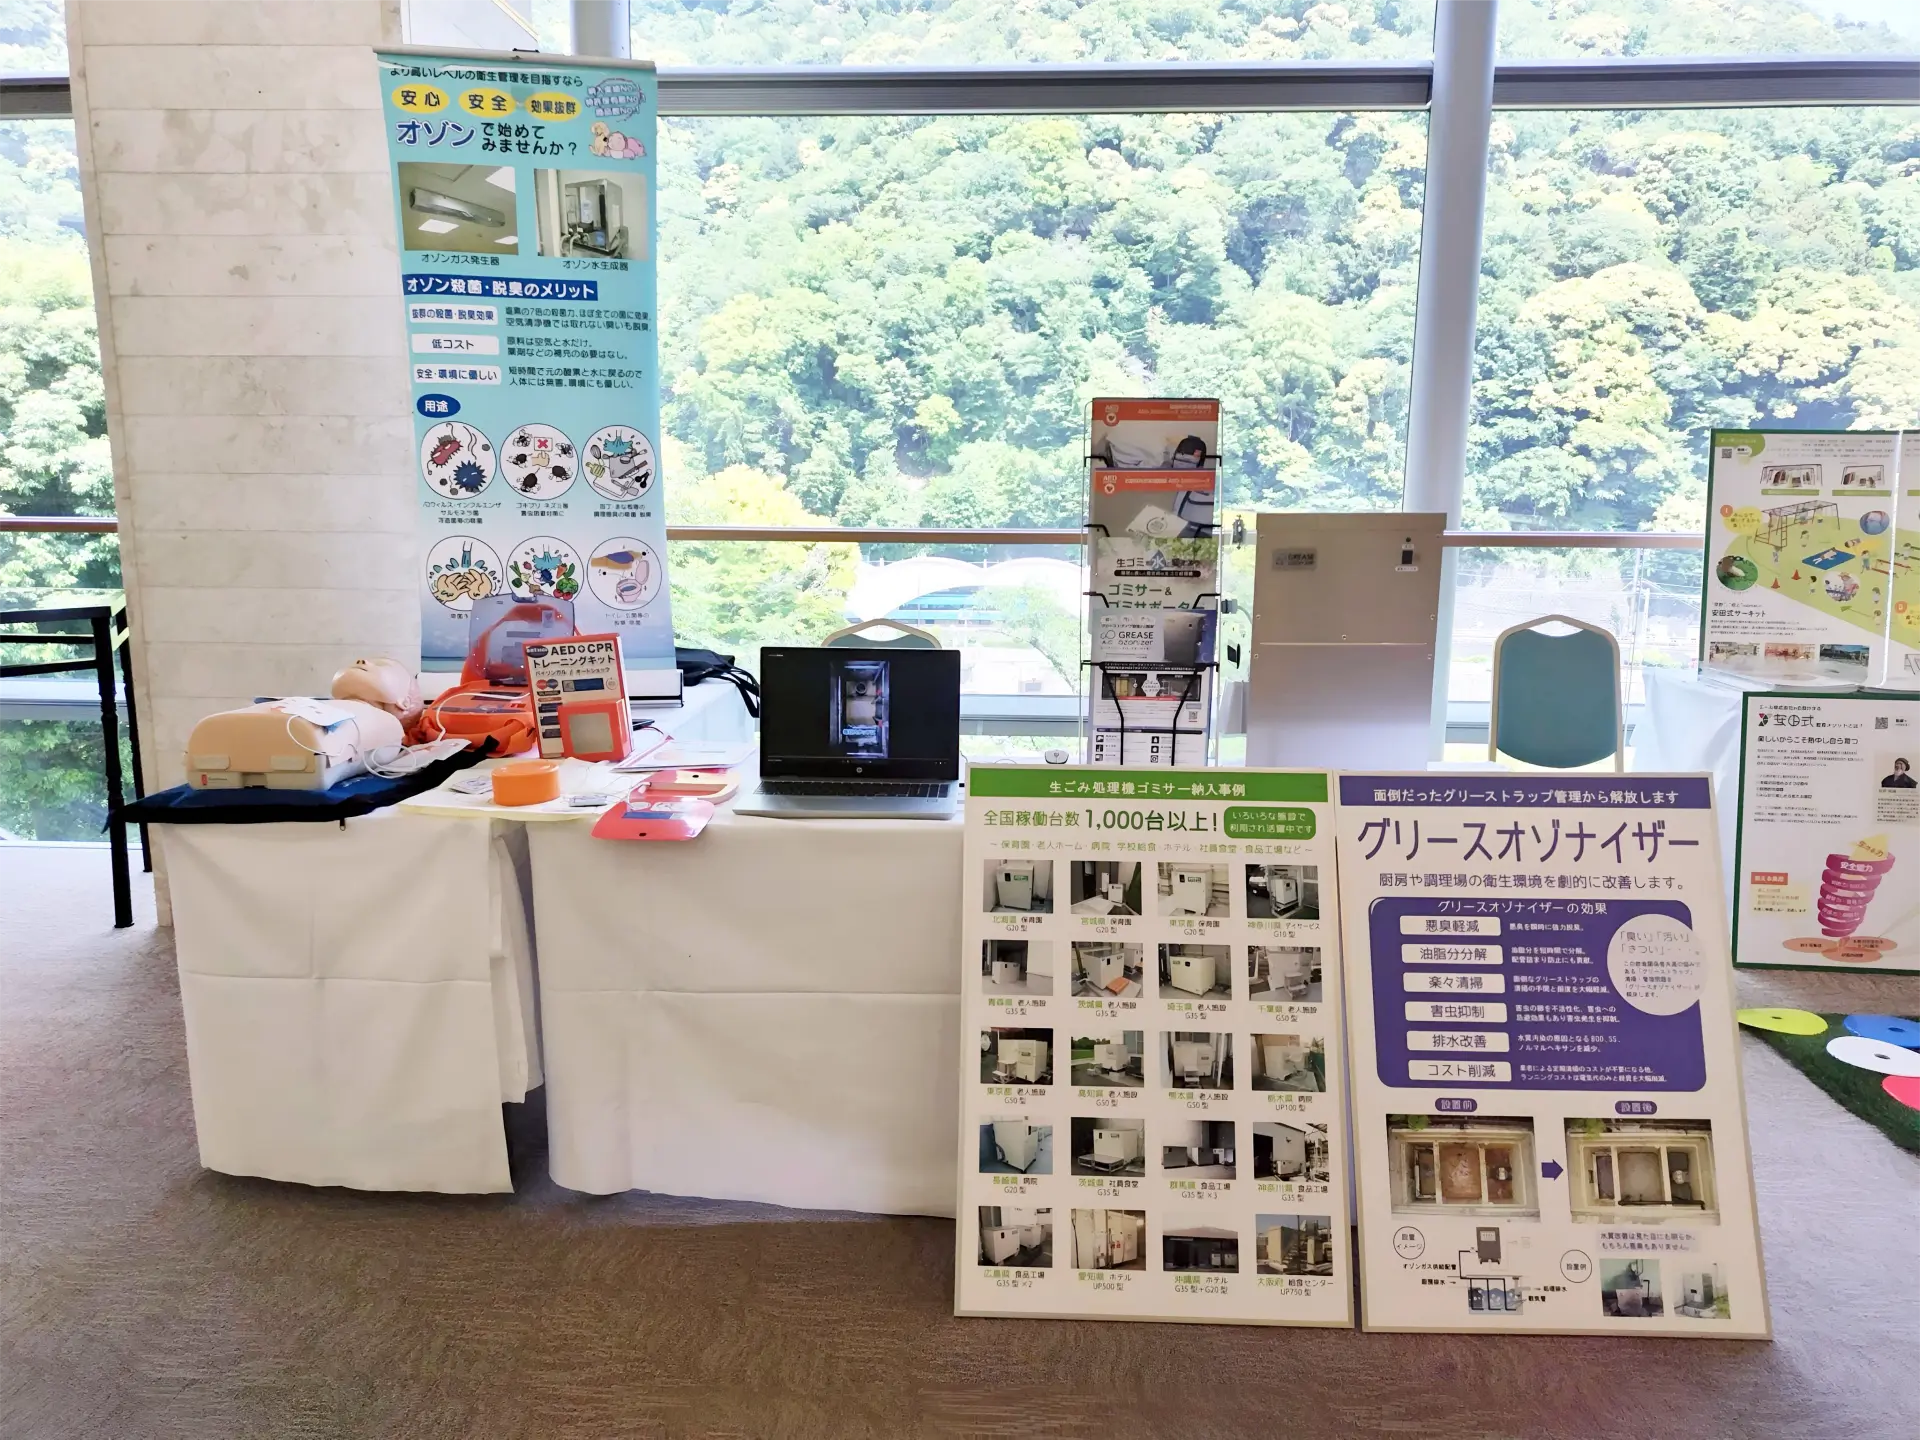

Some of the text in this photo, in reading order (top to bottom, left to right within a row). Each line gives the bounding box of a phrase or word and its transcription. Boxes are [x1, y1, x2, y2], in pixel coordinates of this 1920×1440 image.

[400, 89, 440, 107] 安心
[468, 94, 508, 112] 安全
[531, 99, 576, 115] 効果抜群
[395, 120, 475, 148] オゾン
[480, 122, 545, 139] で始めて
[481, 138, 577, 156] みませんか？
[421, 253, 629, 272] オゾンガス発生器 オゾン水生成器
[406, 277, 595, 300] オゾン殺菌・脱臭のメリット
[431, 339, 475, 351] 低コスト
[424, 400, 448, 412] 用途
[1711, 609, 1767, 618] 安田式サーキット
[1118, 631, 1154, 639] GREASE
[550, 645, 577, 657] AED
[587, 642, 614, 654] CPR
[532, 655, 615, 669] トレーニングキット
[1049, 781, 1246, 798] 生ごみ処理機ゴミサー納入事例
[1373, 789, 1679, 805] 面倒だったグリーストラップ管理から解放します
[983, 809, 1080, 828] 全国稼働台数
[1357, 817, 1700, 863] グリースオゾナイザー
[1379, 872, 1684, 890] 厨房や調理場の衛生環境を劇的に改善します。
[1437, 900, 1609, 915] グリースオゾナイザーの効果
[1425, 919, 1480, 932] 悪臭軽減
[1419, 947, 1488, 961] 油脂分分解
[1428, 976, 1483, 990] 楽々清掃
[1431, 1004, 1485, 1018] 害虫抑制
[1432, 1034, 1488, 1048] 排水改善
[1428, 1063, 1496, 1078] コスト削減
[1440, 1099, 1653, 1113] 設置前 設置後
[1109, 1273, 1132, 1281] ホテル
[1205, 1276, 1229, 1285] ホテル
